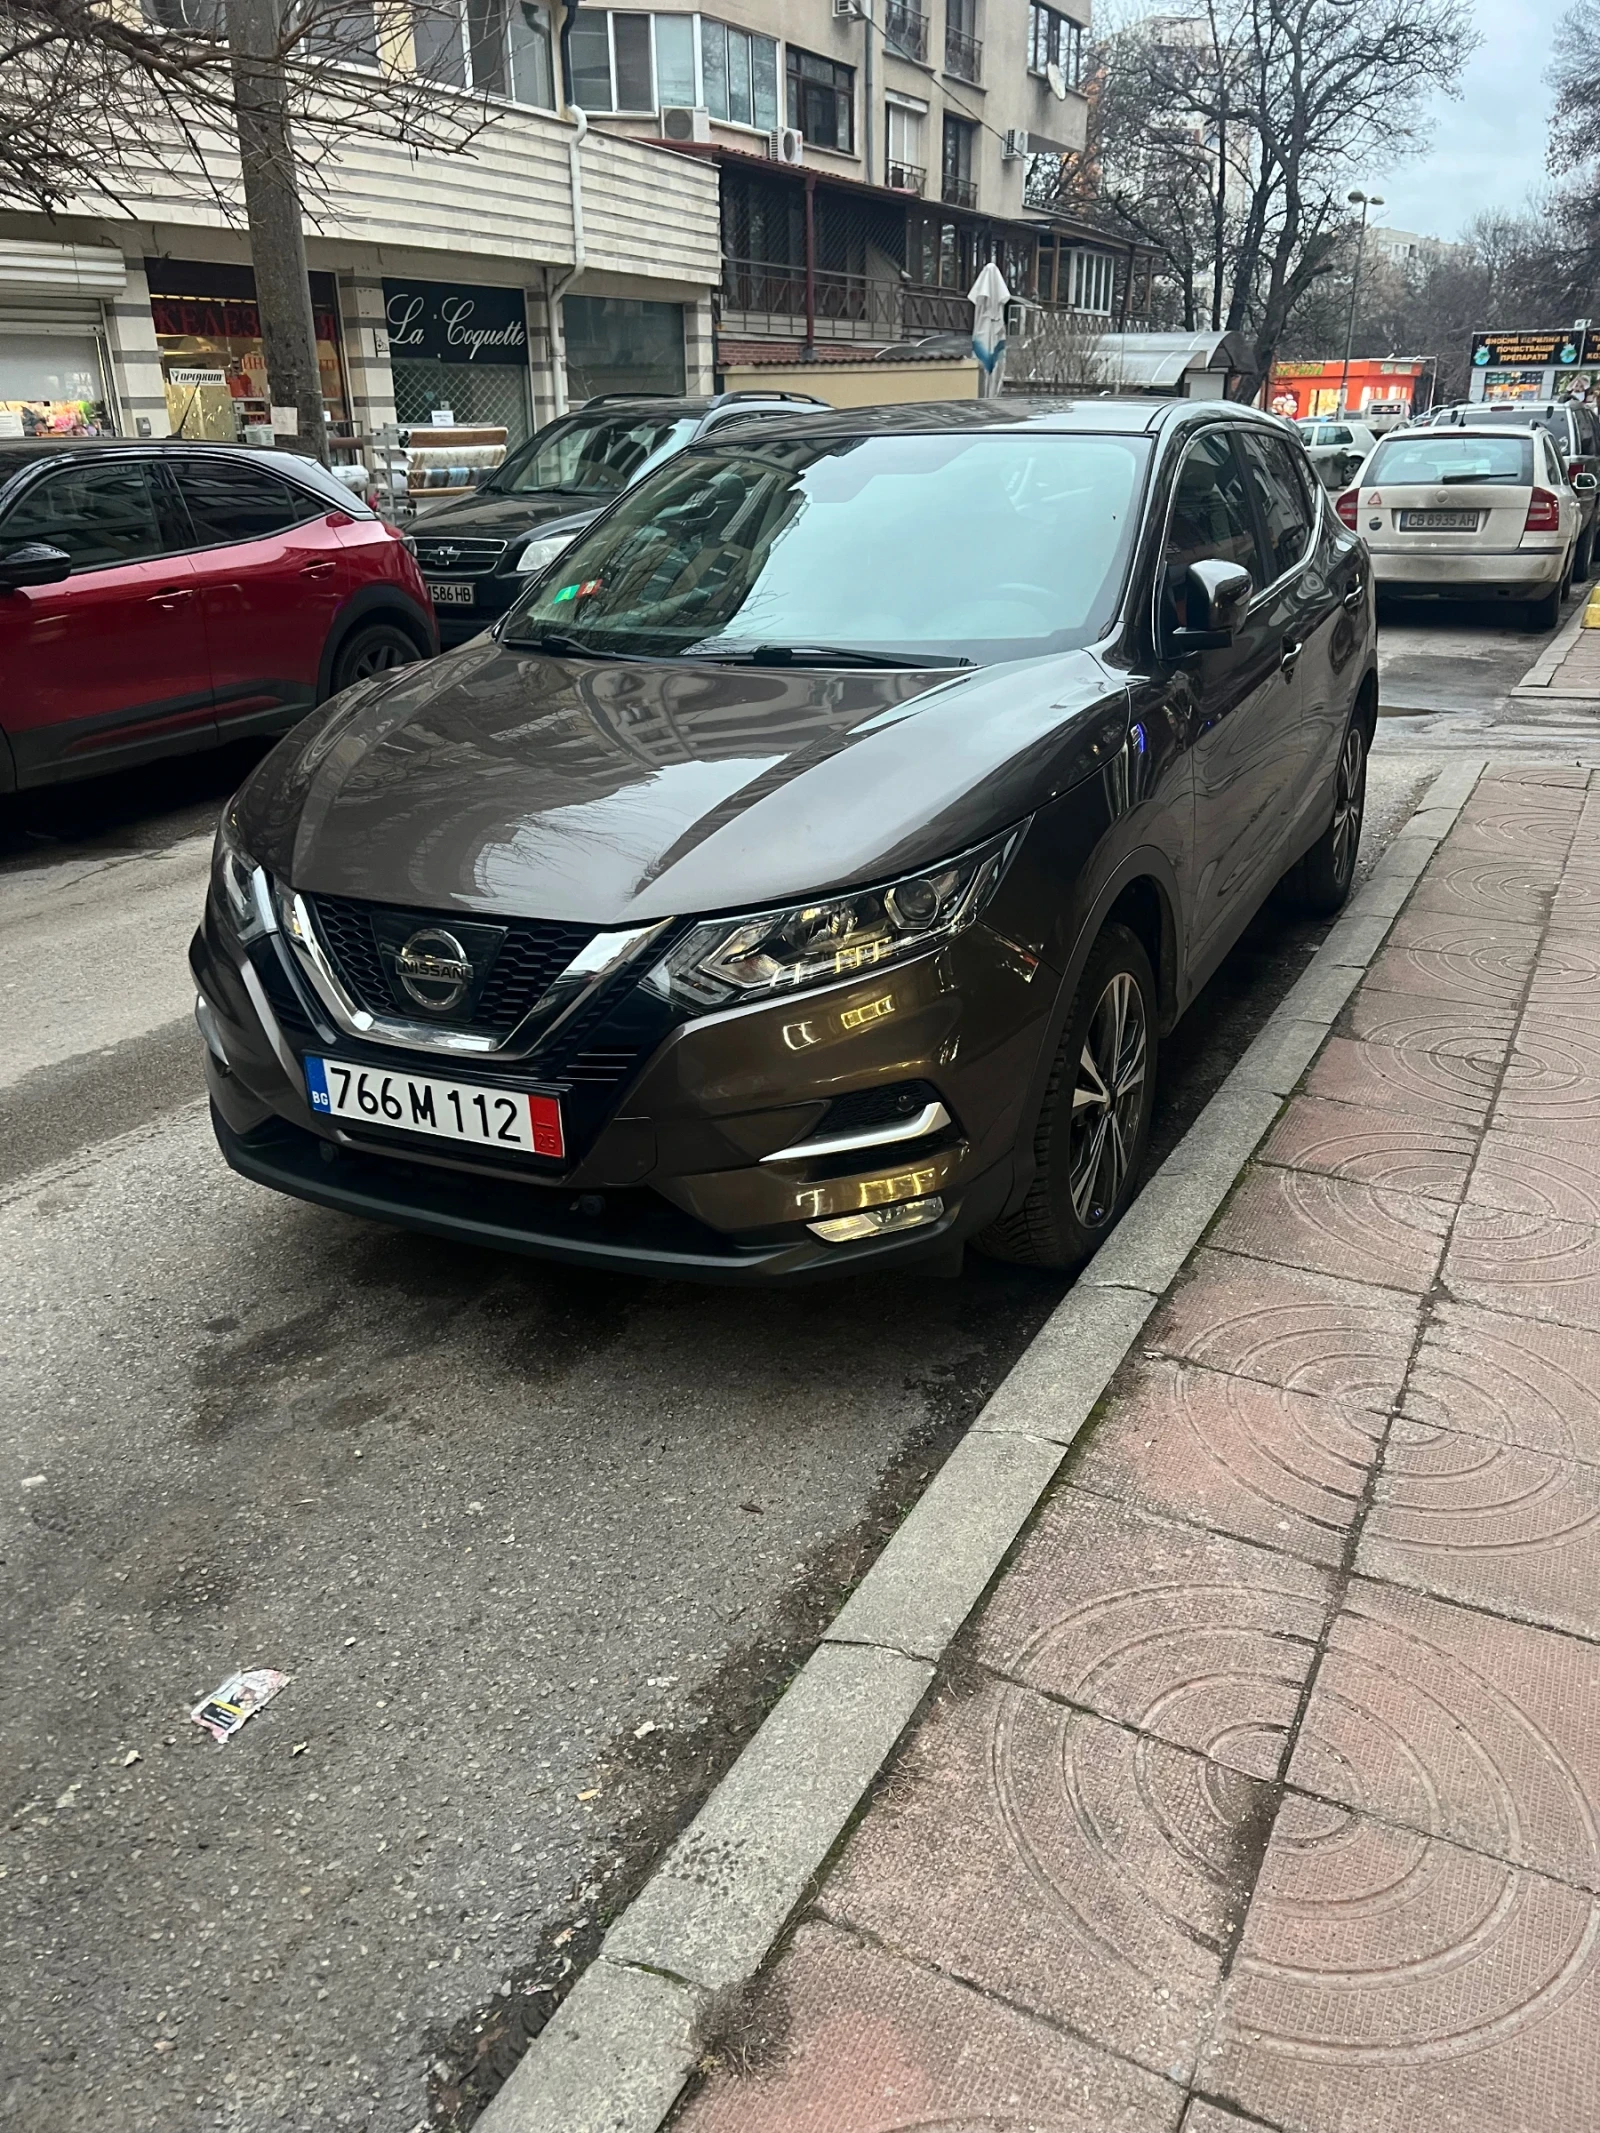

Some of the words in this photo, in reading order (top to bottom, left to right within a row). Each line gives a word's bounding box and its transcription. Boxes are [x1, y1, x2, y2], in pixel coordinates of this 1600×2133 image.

[387, 294, 425, 344] La
[441, 297, 526, 360] Coquette
[1500, 353, 1549, 362] ПРЕПАРАТИ
[1427, 513, 1457, 527] 8935
[403, 961, 464, 979] NISSAN
[311, 1090, 329, 1106] BG
